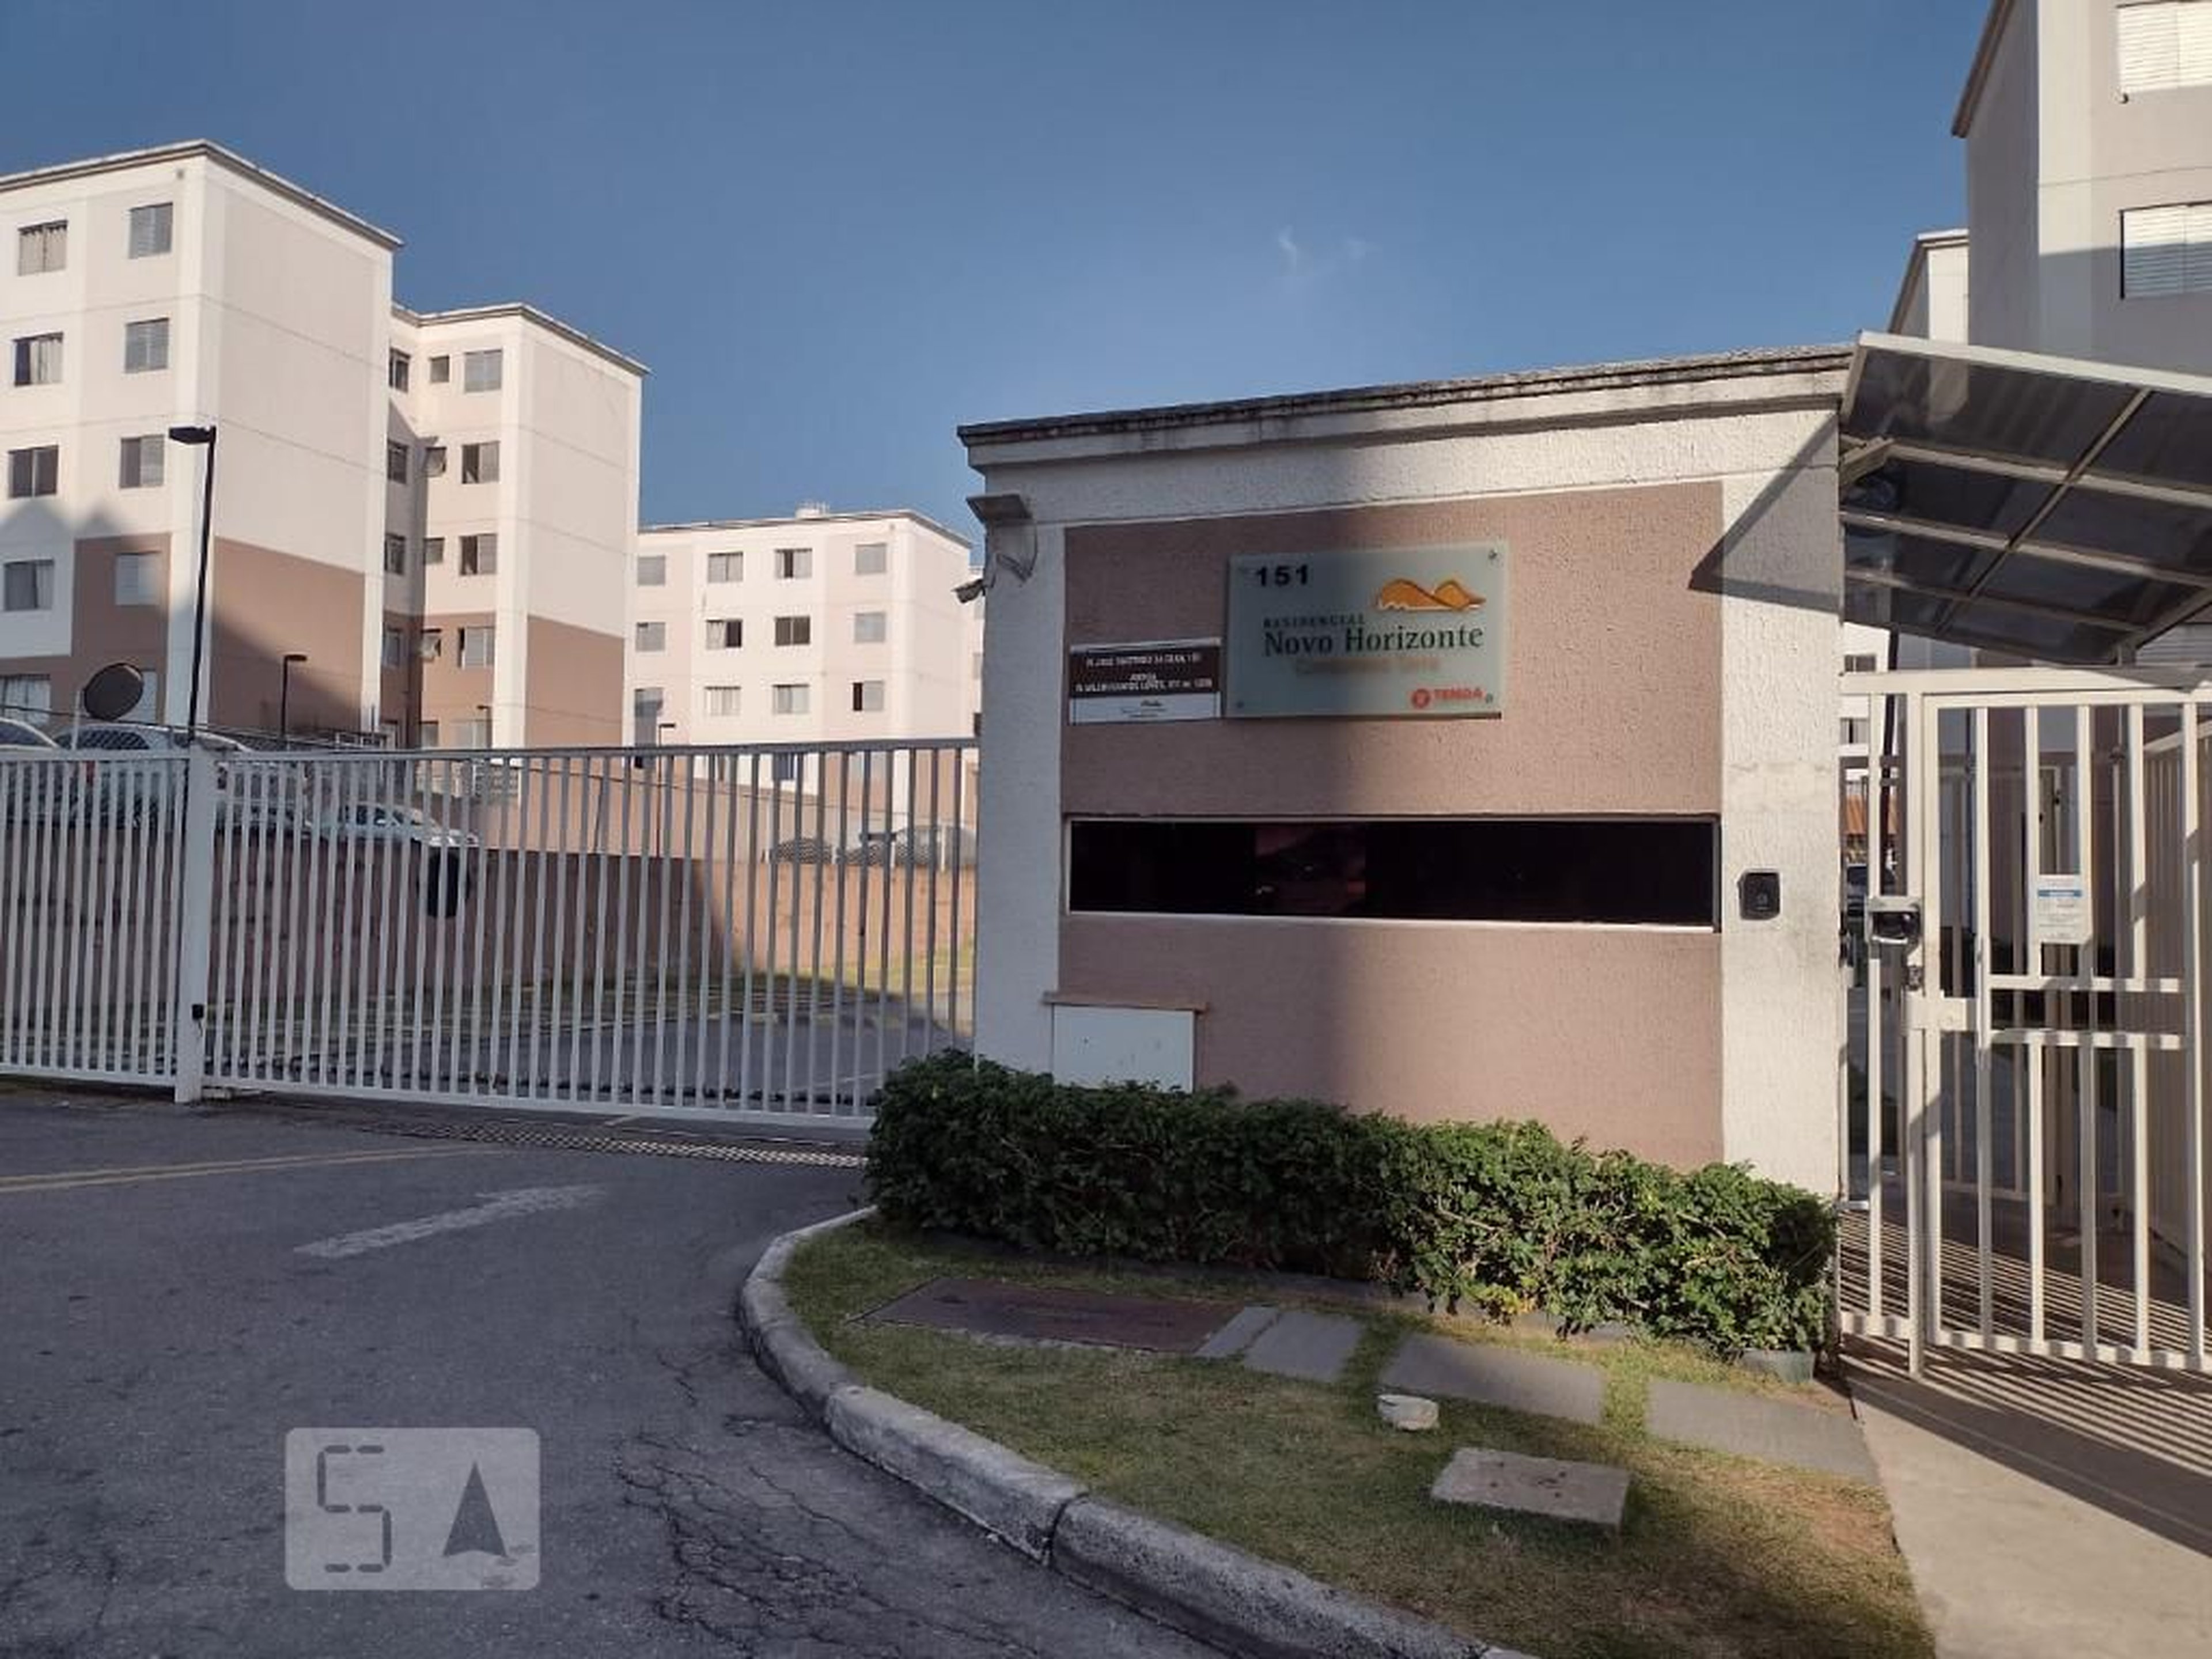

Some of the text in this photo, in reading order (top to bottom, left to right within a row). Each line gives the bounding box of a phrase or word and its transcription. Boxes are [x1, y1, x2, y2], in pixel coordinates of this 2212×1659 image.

[1255, 565, 1309, 586] 151
[1264, 624, 1484, 657] Novo Horizonte
